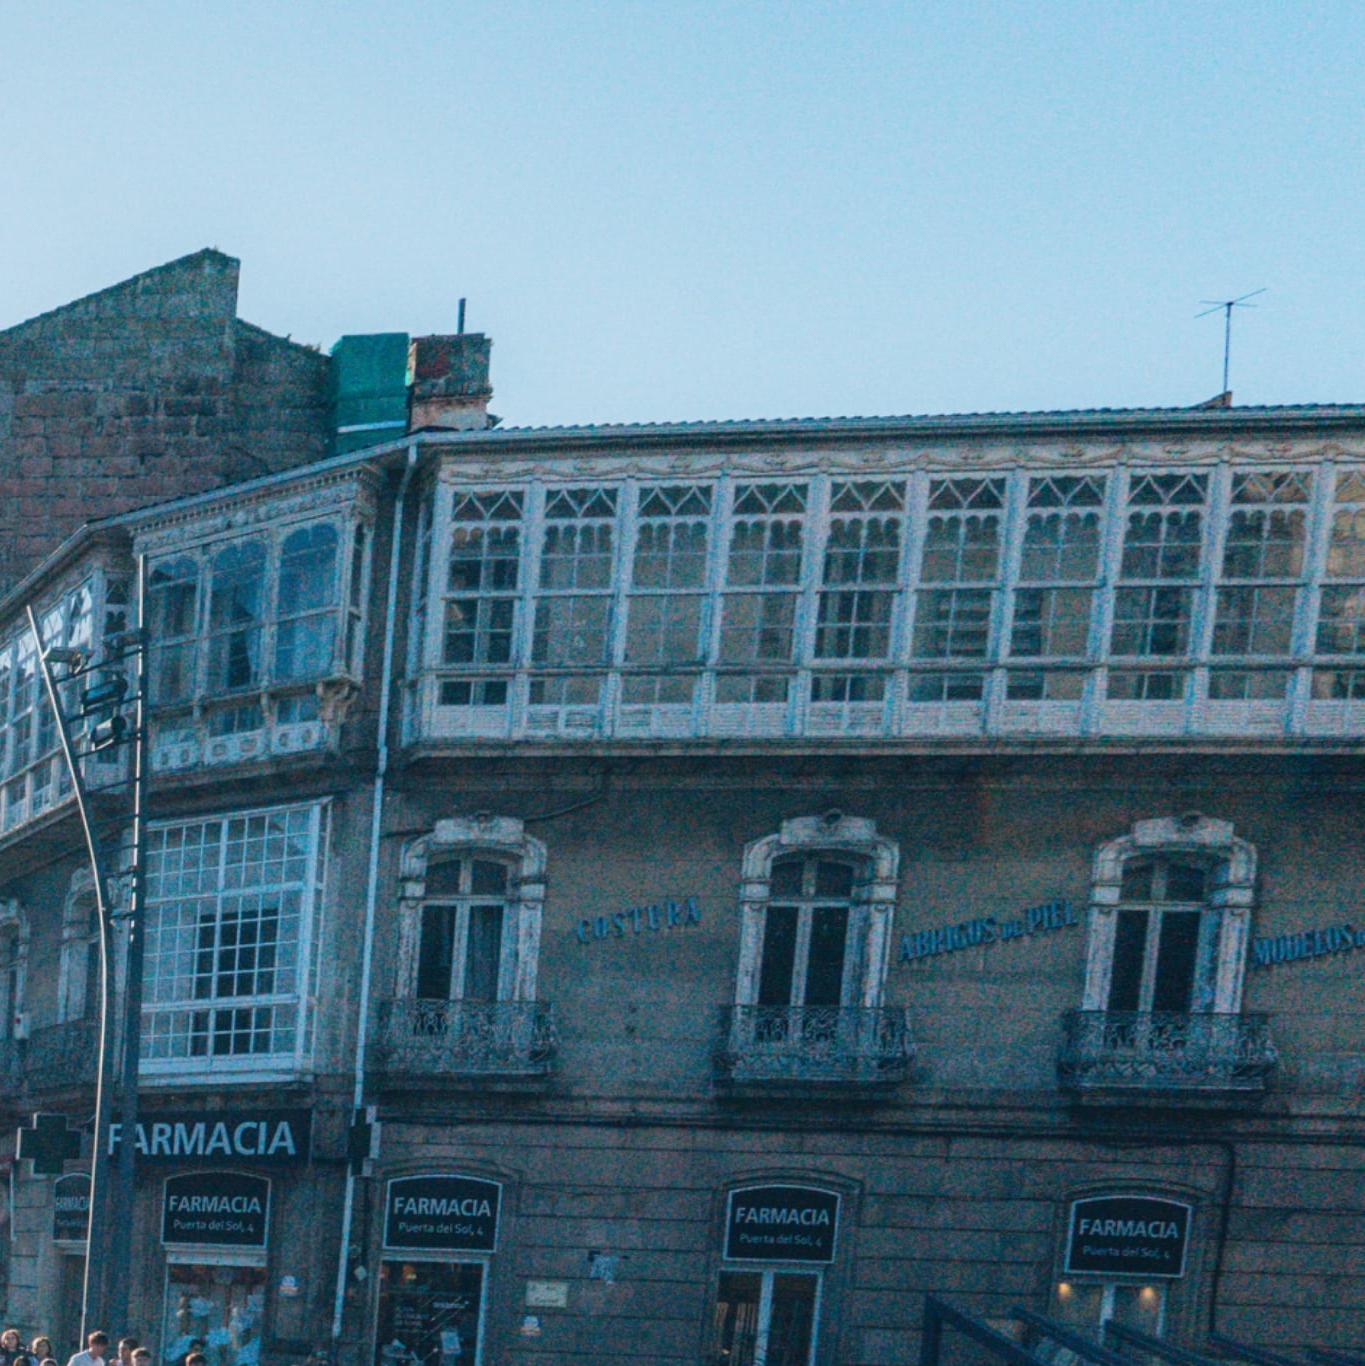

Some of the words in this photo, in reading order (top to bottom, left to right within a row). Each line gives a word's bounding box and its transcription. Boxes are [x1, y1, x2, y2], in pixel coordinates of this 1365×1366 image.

[575, 897, 702, 944] COSTURA
[897, 916, 997, 962] ABRIGOS
[1026, 900, 1080, 938] PIEL
[1253, 924, 1354, 967] MODELOS
[107, 1120, 297, 1156] FARMACIA
[169, 1195, 262, 1214] FARMACIA
[394, 1197, 491, 1217] FARMACIA
[173, 1218, 204, 1231] Puerta
[209, 1220, 223, 1231] del
[734, 1206, 830, 1226] FARMACIA
[399, 1222, 434, 1234] Puerta
[437, 1223, 453, 1234] del
[1079, 1218, 1179, 1239] FARMACIA
